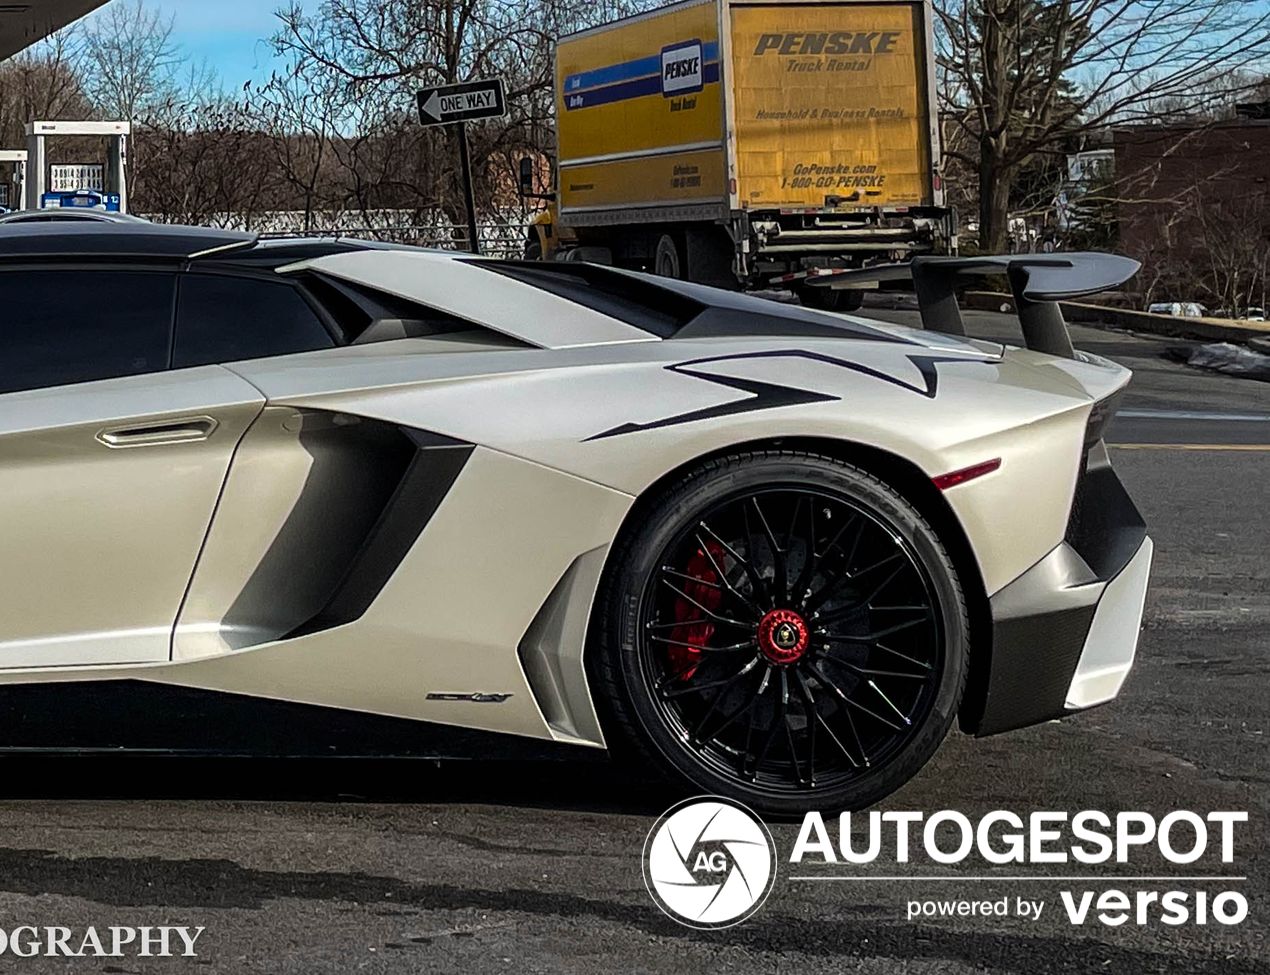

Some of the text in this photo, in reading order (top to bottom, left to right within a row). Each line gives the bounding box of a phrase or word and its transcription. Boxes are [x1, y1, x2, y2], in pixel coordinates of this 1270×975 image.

[753, 31, 901, 56] PENSKE
[664, 56, 699, 81] PENSKE
[786, 58, 872, 72] Truck Rental
[440, 91, 492, 111] ONE WAY
[756, 107, 904, 119] Household & Business Rentals
[793, 163, 877, 175] GoPenske.com
[781, 175, 886, 189] 1-800-GO-PENSKE
